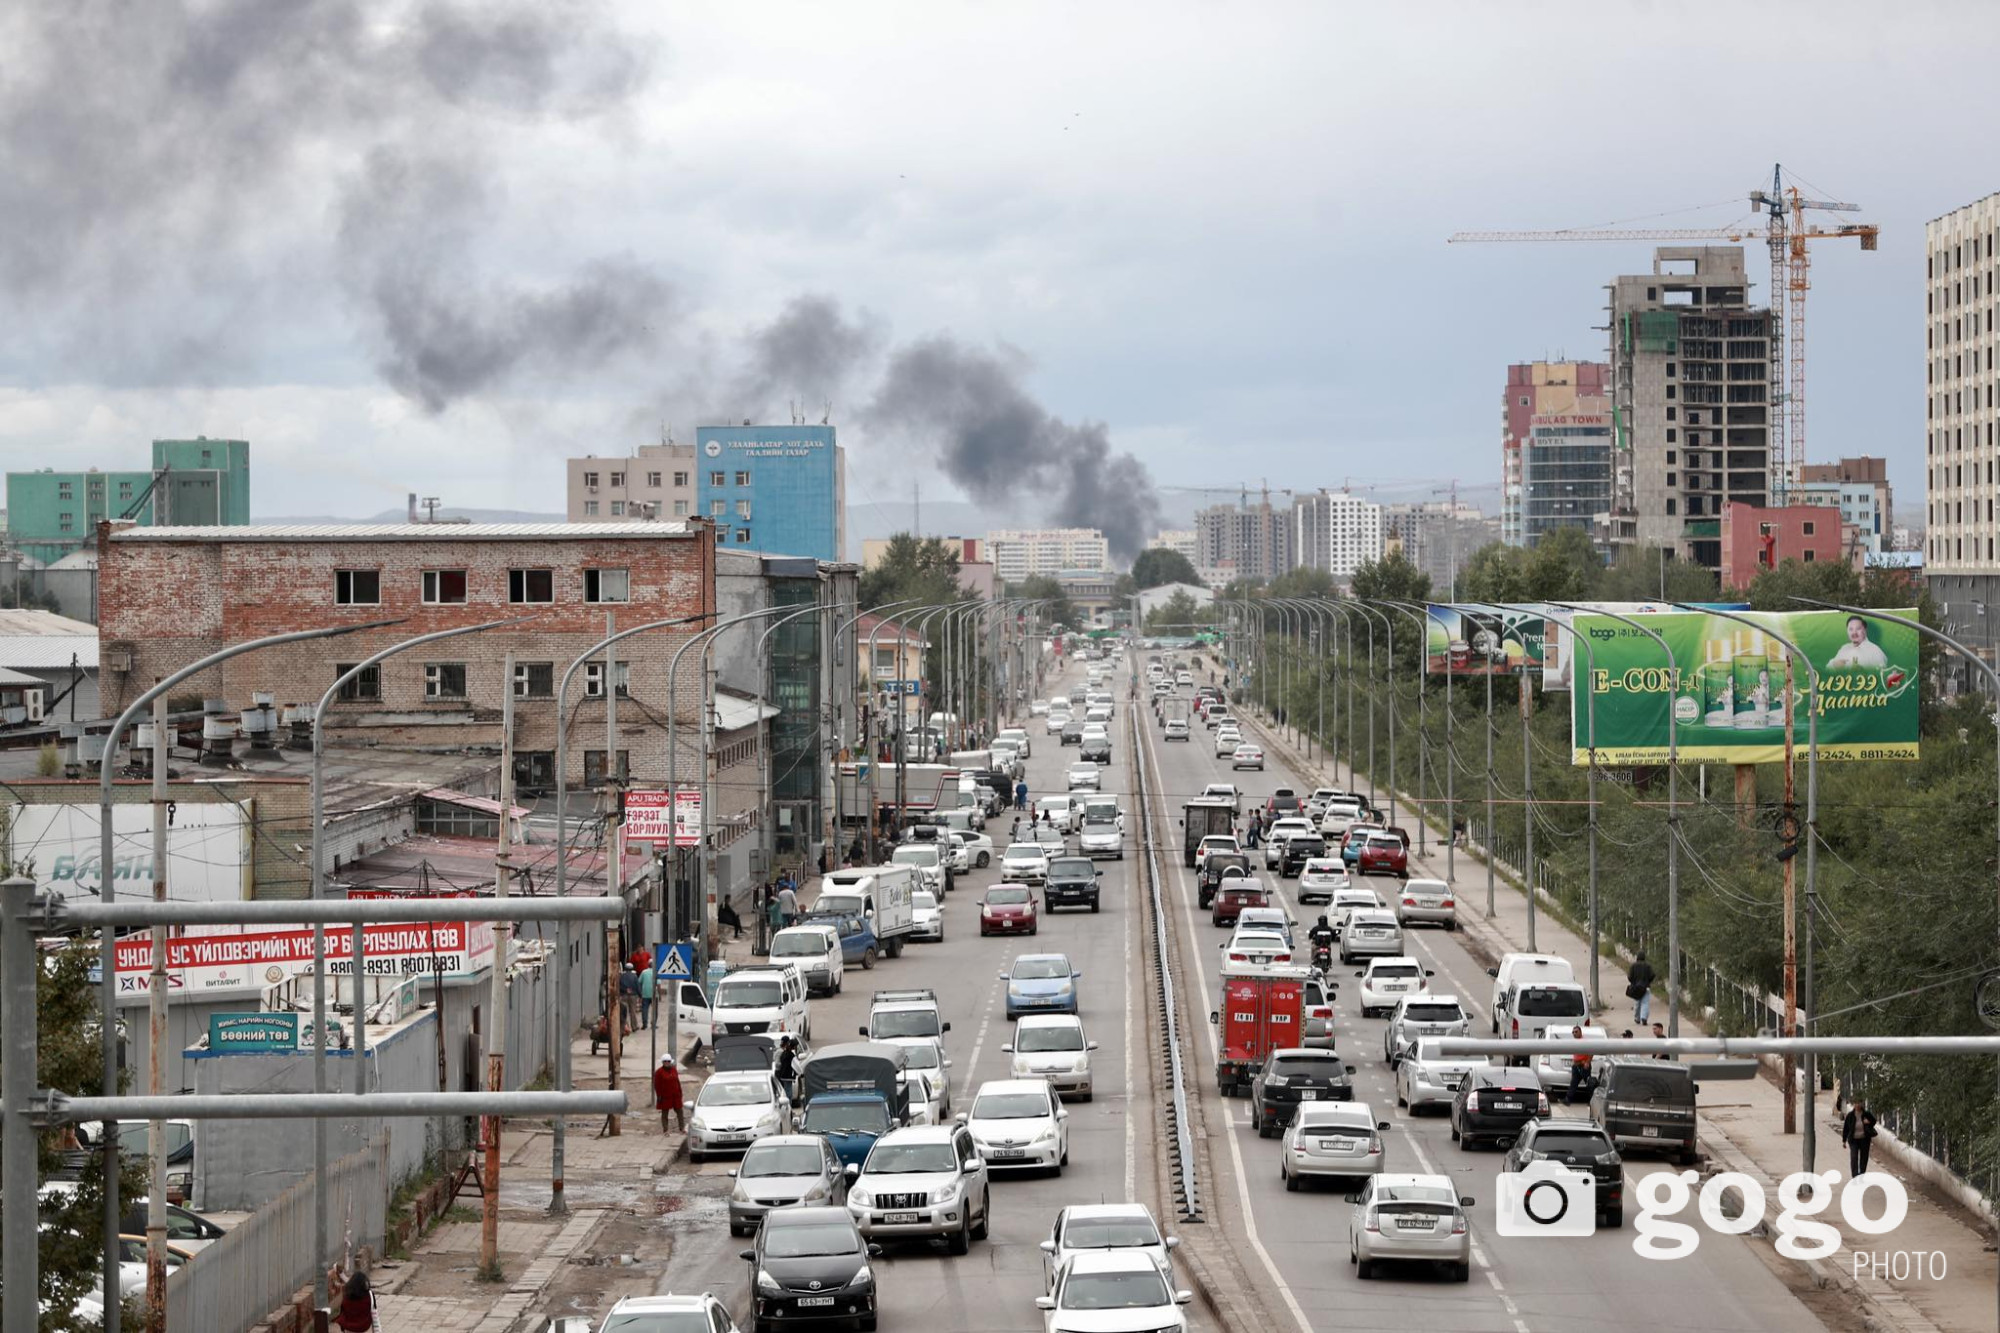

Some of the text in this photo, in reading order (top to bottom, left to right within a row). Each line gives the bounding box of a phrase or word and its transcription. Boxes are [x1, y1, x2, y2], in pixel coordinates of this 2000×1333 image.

[1570, 415, 1602, 424] TOWN
[1860, 750, 1915, 759] 8811-2424
[627, 794, 643, 802] APU
[644, 794, 670, 803] TRADIN
[171, 945, 190, 964] УС
[192, 935, 290, 962] ҮЙЛДВЭРИЙН
[432, 928, 458, 948] ТӨВ
[206, 978, 241, 987] ВИТАФИТ
[221, 1029, 290, 1041] БӨӨНИЙ ТӨВ
